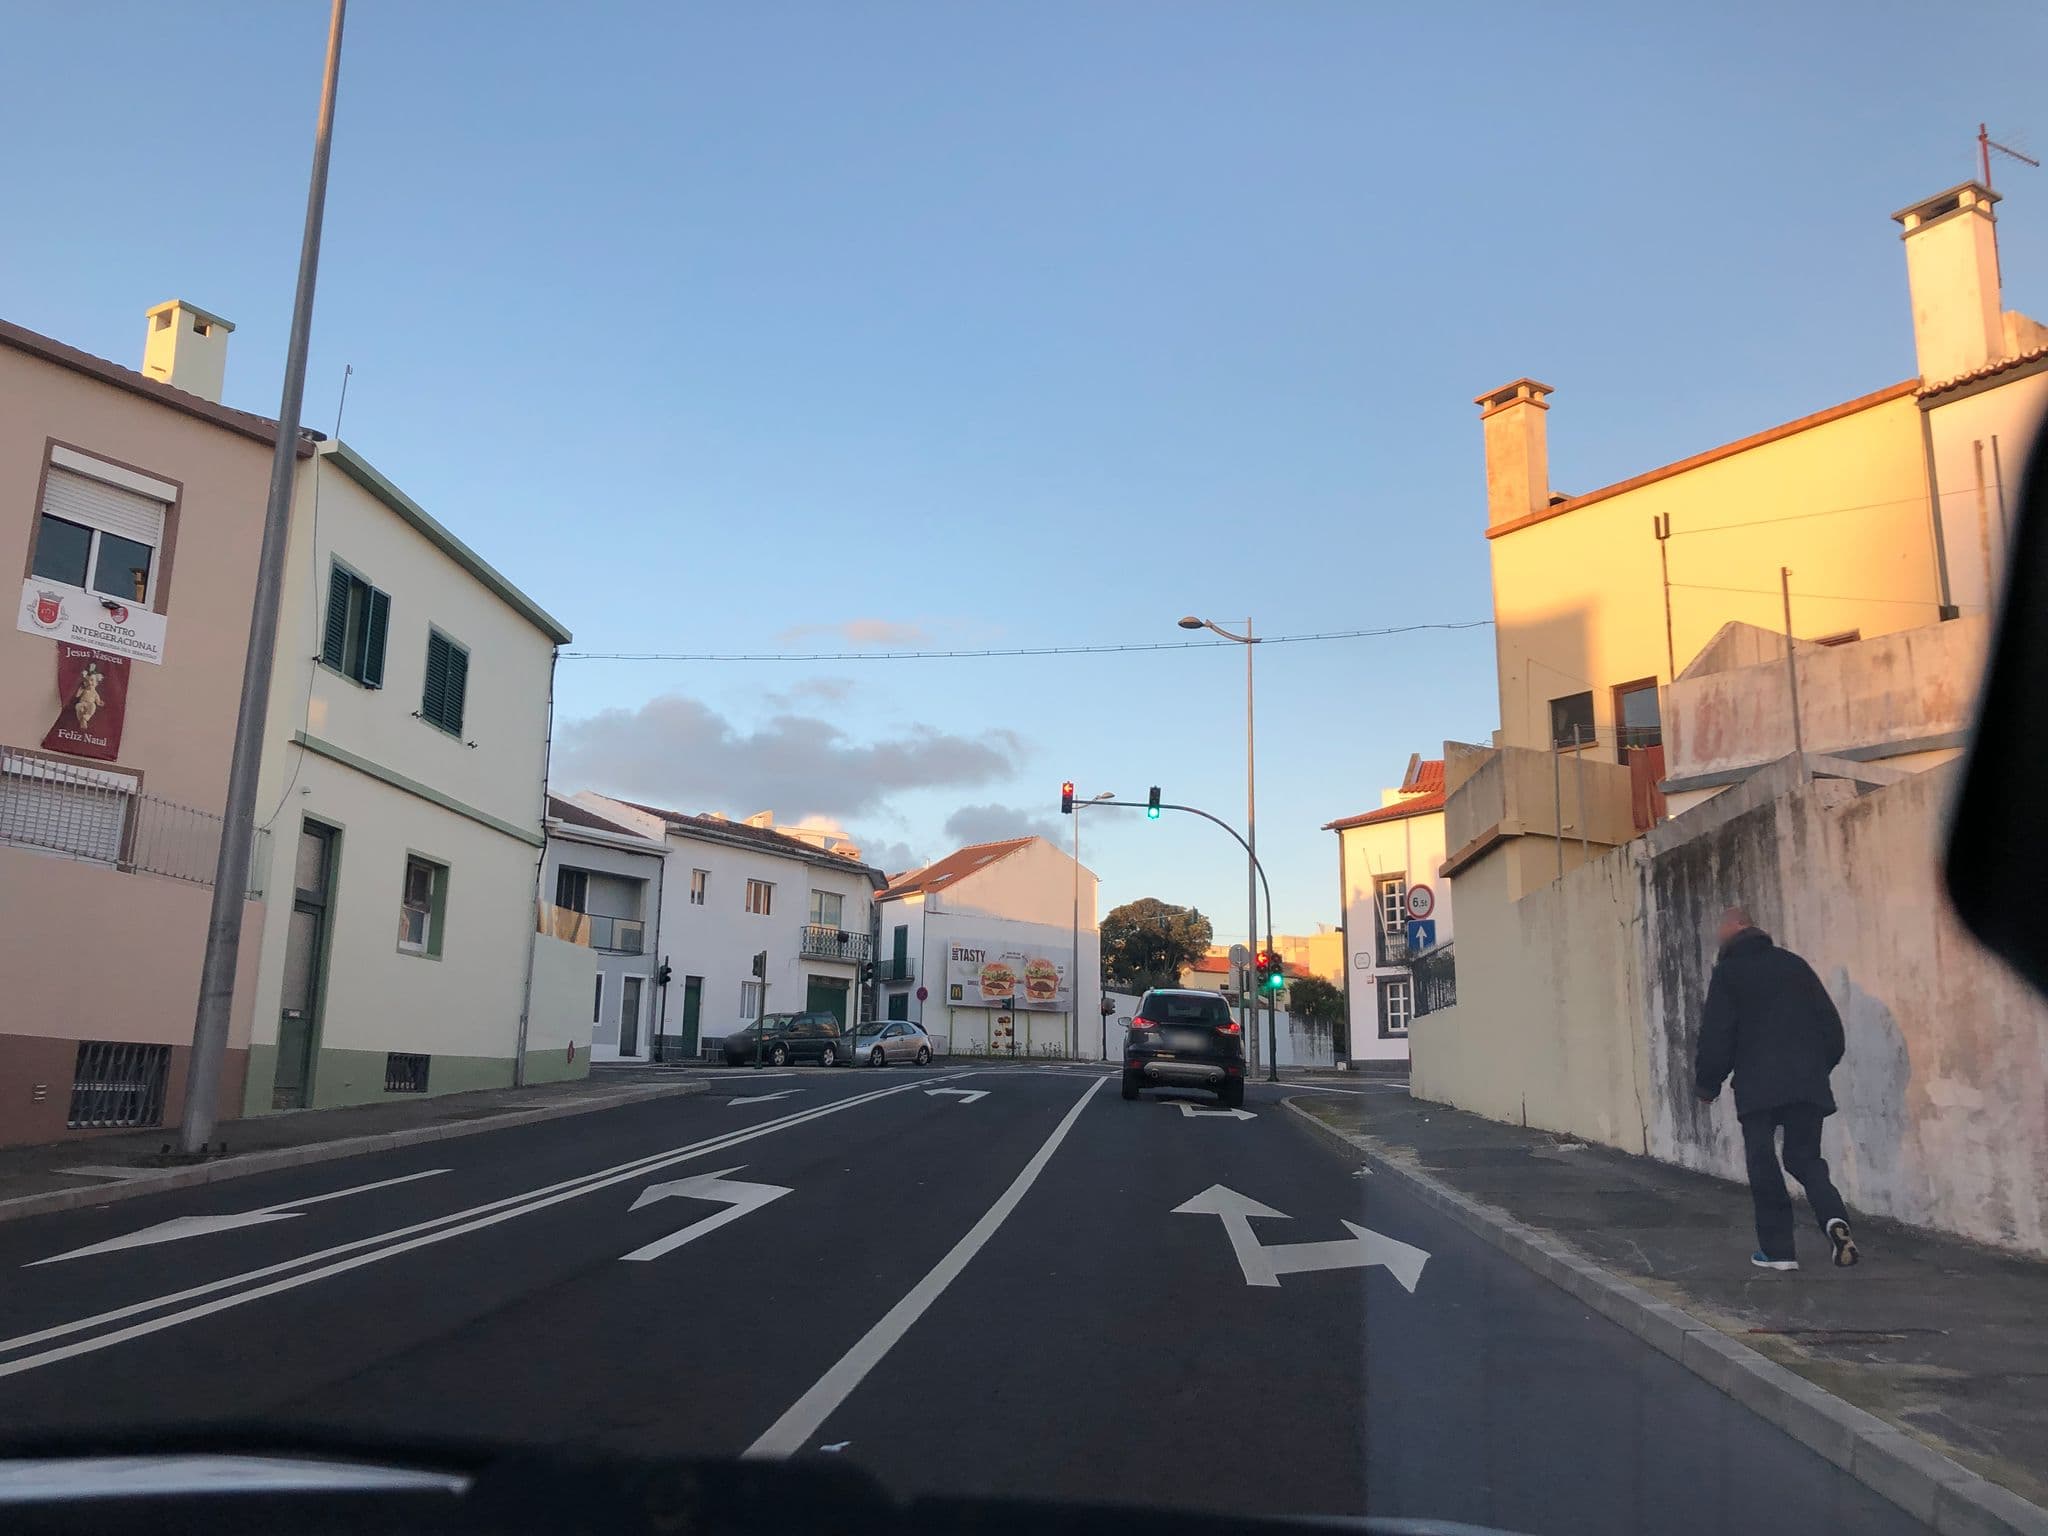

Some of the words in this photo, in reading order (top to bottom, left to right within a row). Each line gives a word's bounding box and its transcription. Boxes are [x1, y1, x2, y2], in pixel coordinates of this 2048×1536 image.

[98, 621, 136, 637] CENTRO
[71, 624, 158, 653] INTERGERACIONAL
[66, 647, 91, 658] Jesus
[92, 649, 123, 665] Nasceu
[58, 728, 82, 742] Feliz
[83, 733, 107, 747] Natal
[952, 948, 960, 961] BIG
[959, 948, 986, 963] TASTY
